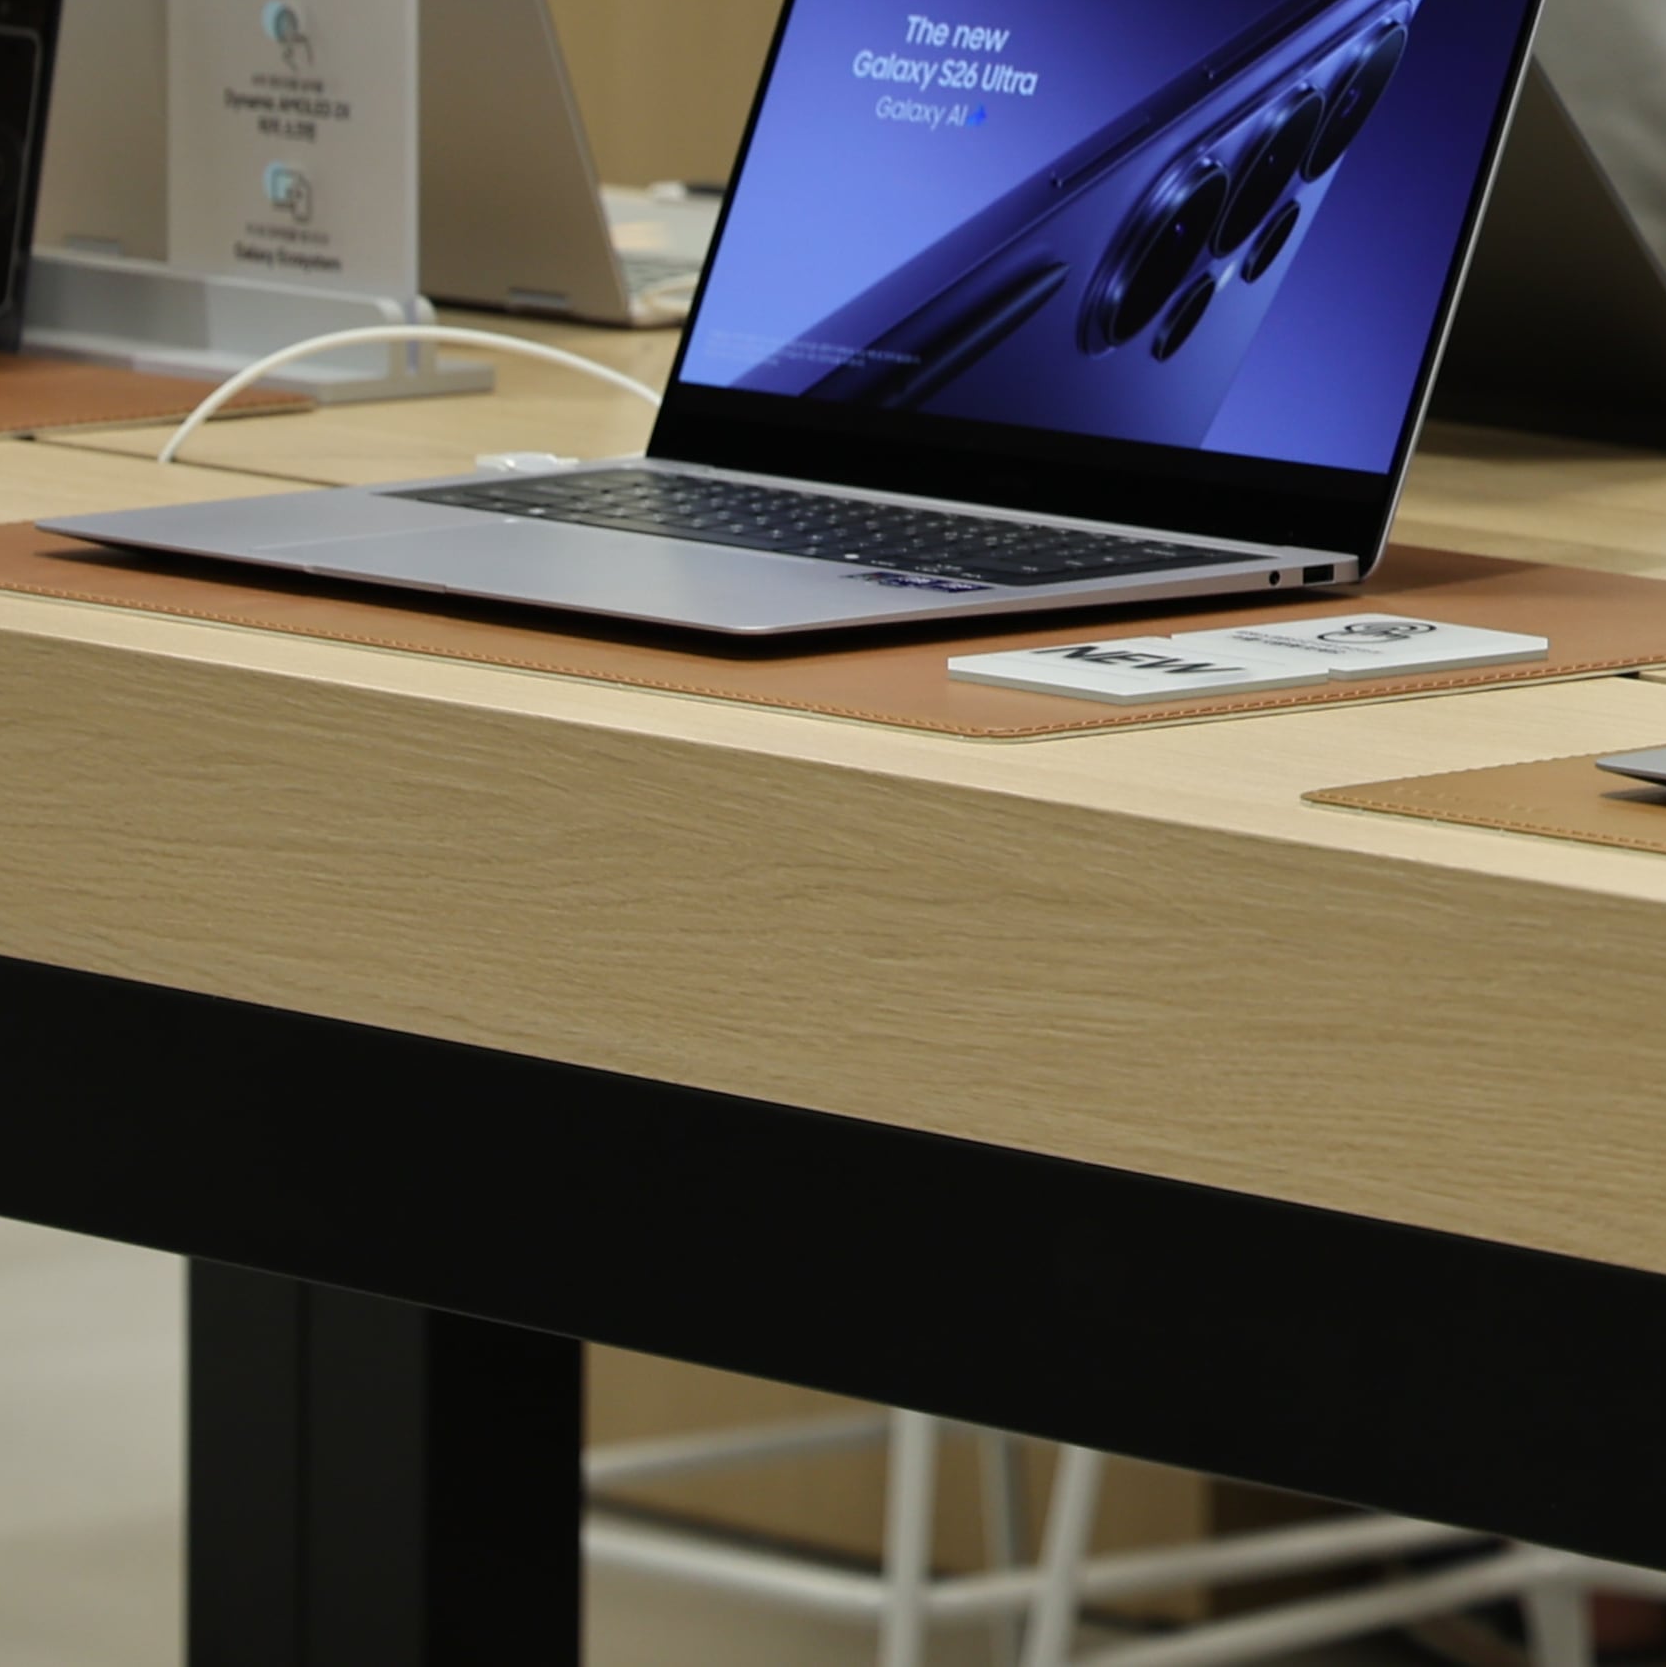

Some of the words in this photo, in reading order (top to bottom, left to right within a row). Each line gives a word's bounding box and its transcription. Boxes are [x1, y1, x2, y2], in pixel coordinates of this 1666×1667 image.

[905, 14, 949, 47] The
[952, 24, 1010, 53] new
[852, 49, 938, 92] Galaxy
[938, 58, 979, 90] S26
[981, 63, 1039, 96] Ultra
[876, 95, 945, 131] Galaxy
[946, 103, 970, 127] AI
[1031, 643, 1247, 676] NEW
